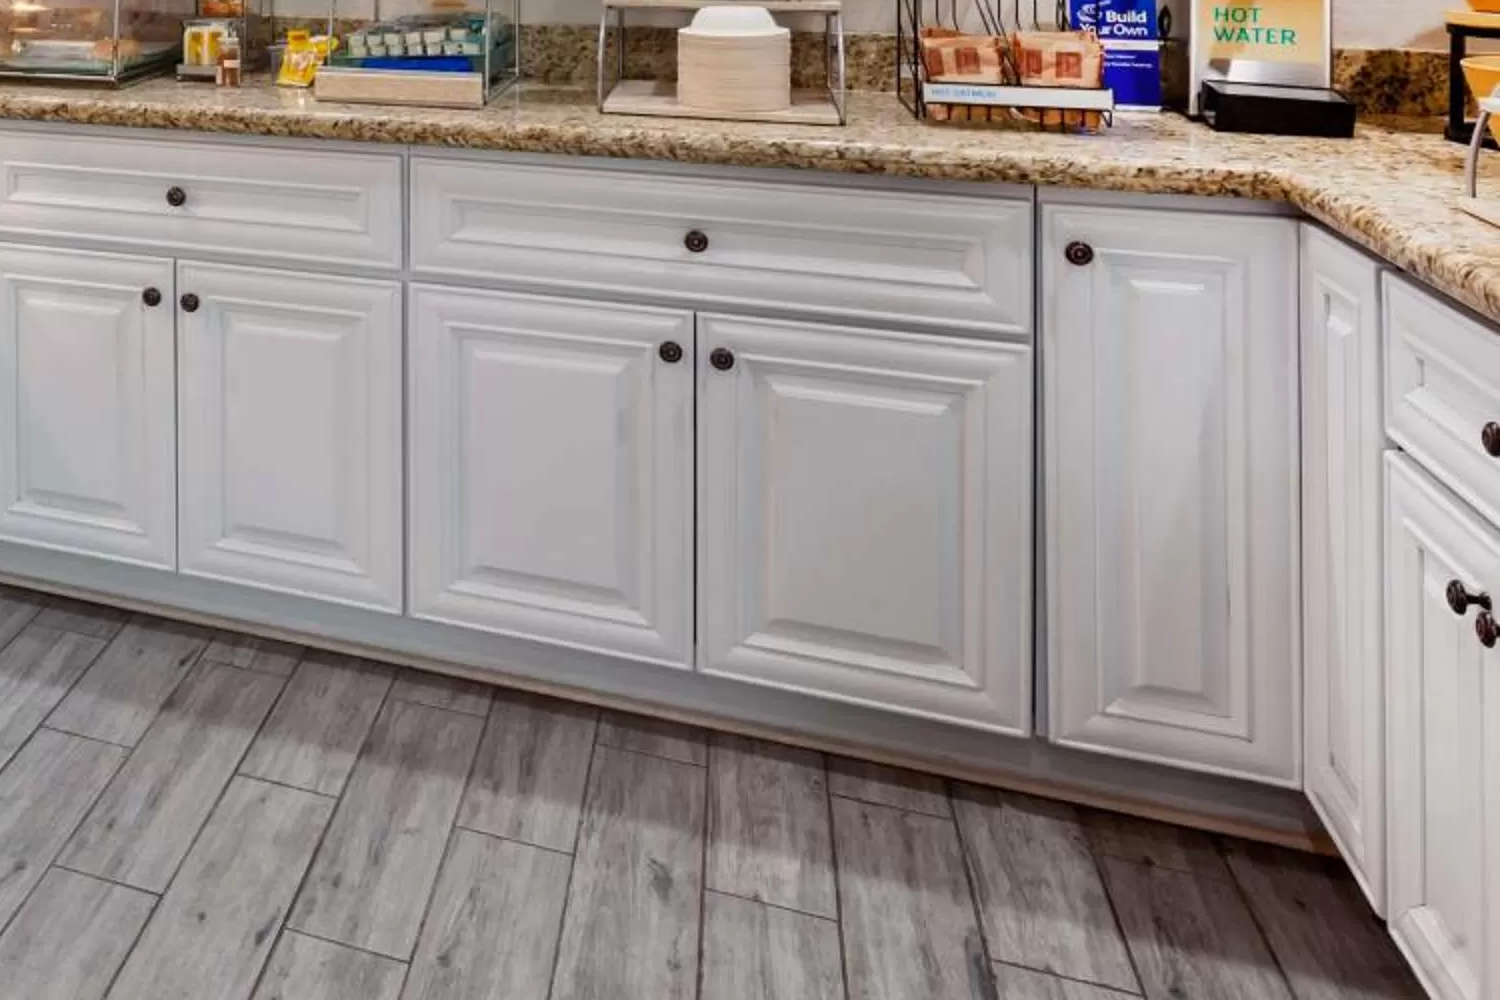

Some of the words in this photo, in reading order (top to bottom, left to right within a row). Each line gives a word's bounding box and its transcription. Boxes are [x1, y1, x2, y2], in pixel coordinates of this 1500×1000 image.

[1105, 10, 1147, 23] Build
[1214, 7, 1262, 23] HOT
[1113, 23, 1148, 36] Own
[1213, 27, 1296, 45] WATER
